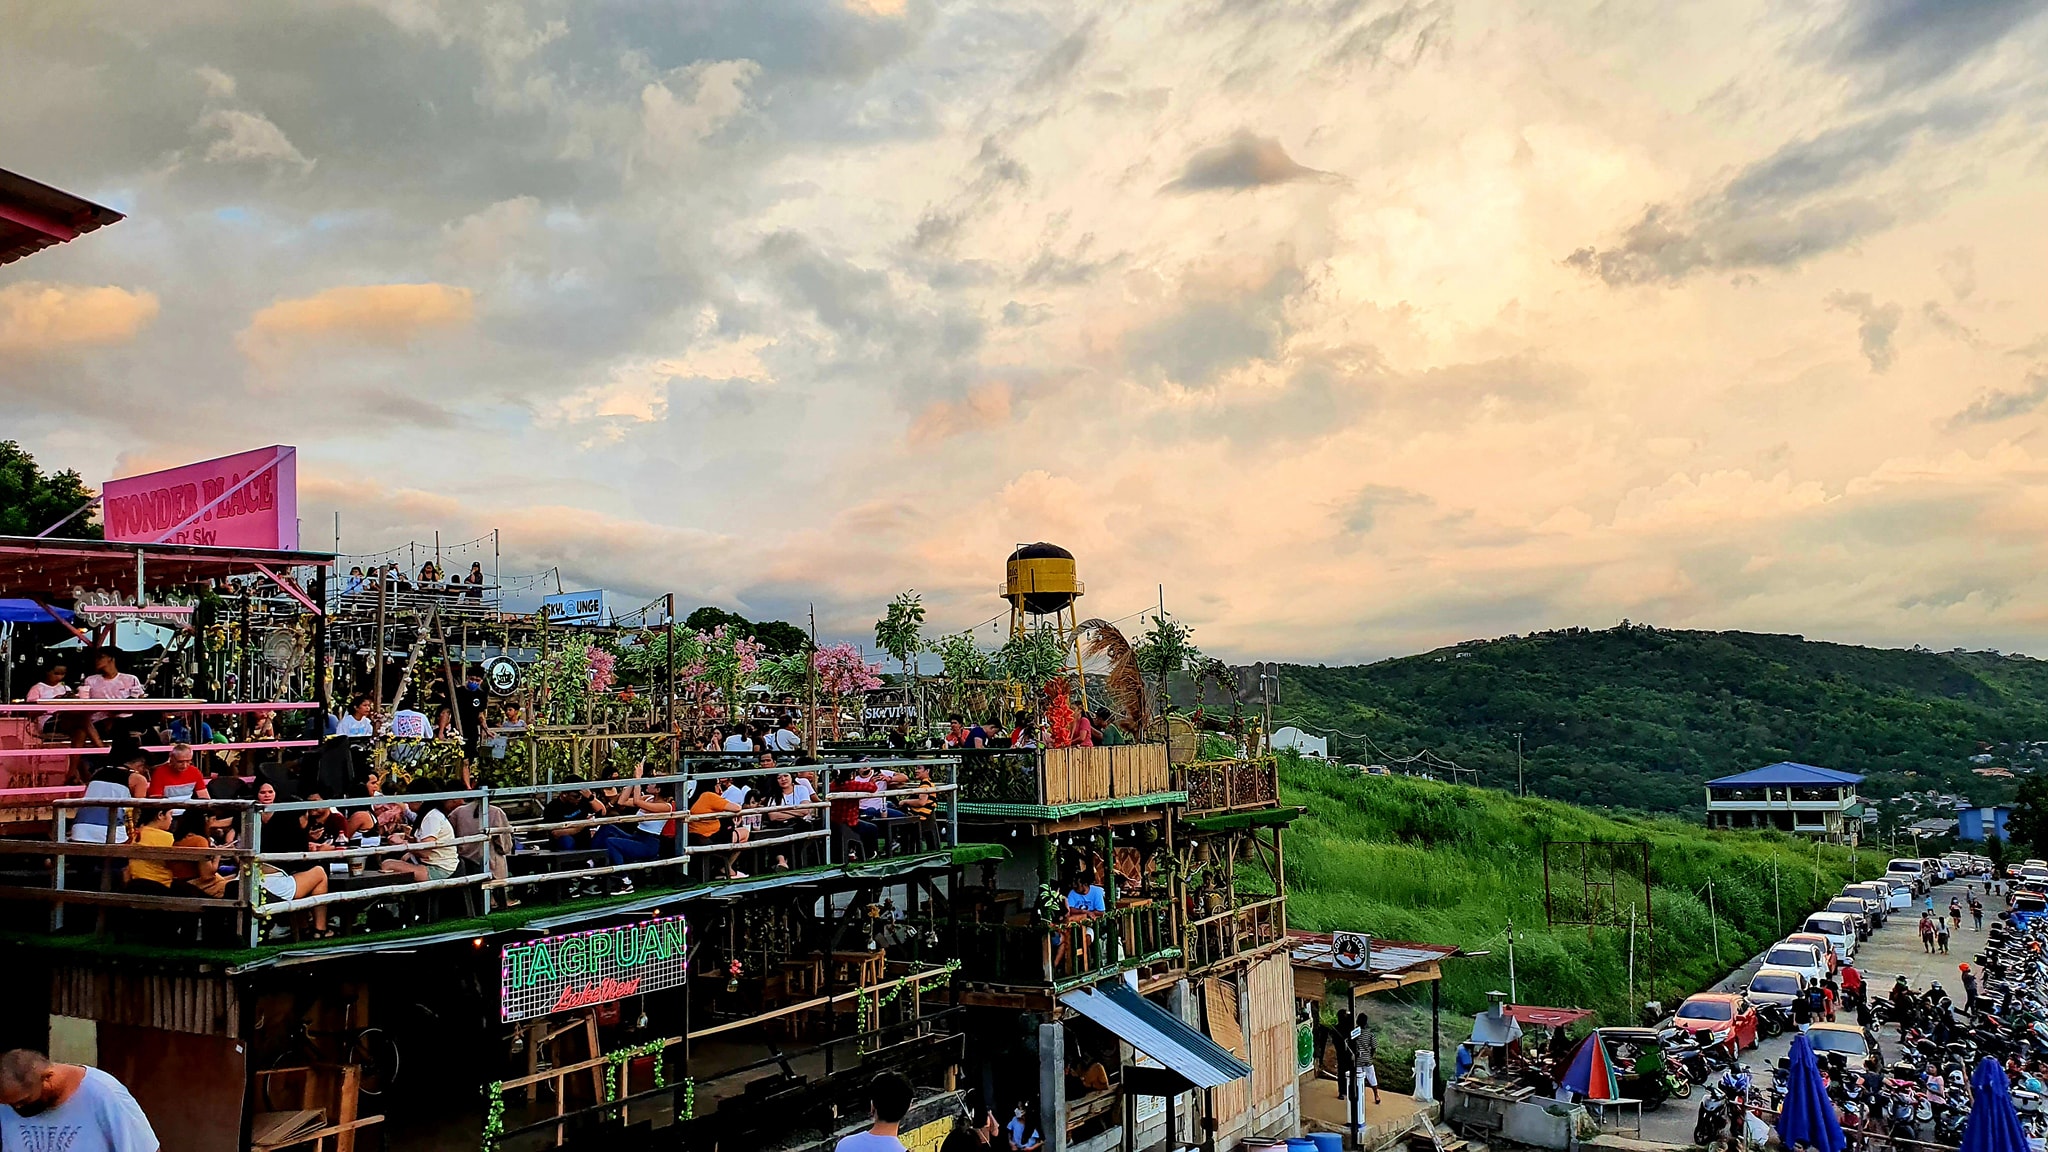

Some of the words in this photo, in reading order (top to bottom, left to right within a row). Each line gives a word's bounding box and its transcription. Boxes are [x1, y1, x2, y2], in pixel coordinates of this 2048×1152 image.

[109, 482, 200, 537] WONDER
[203, 467, 273, 522] PLACE
[507, 919, 686, 988] TAGPUAN
[1333, 934, 1350, 954] COFFEE
[1351, 936, 1365, 959] CLOUD
